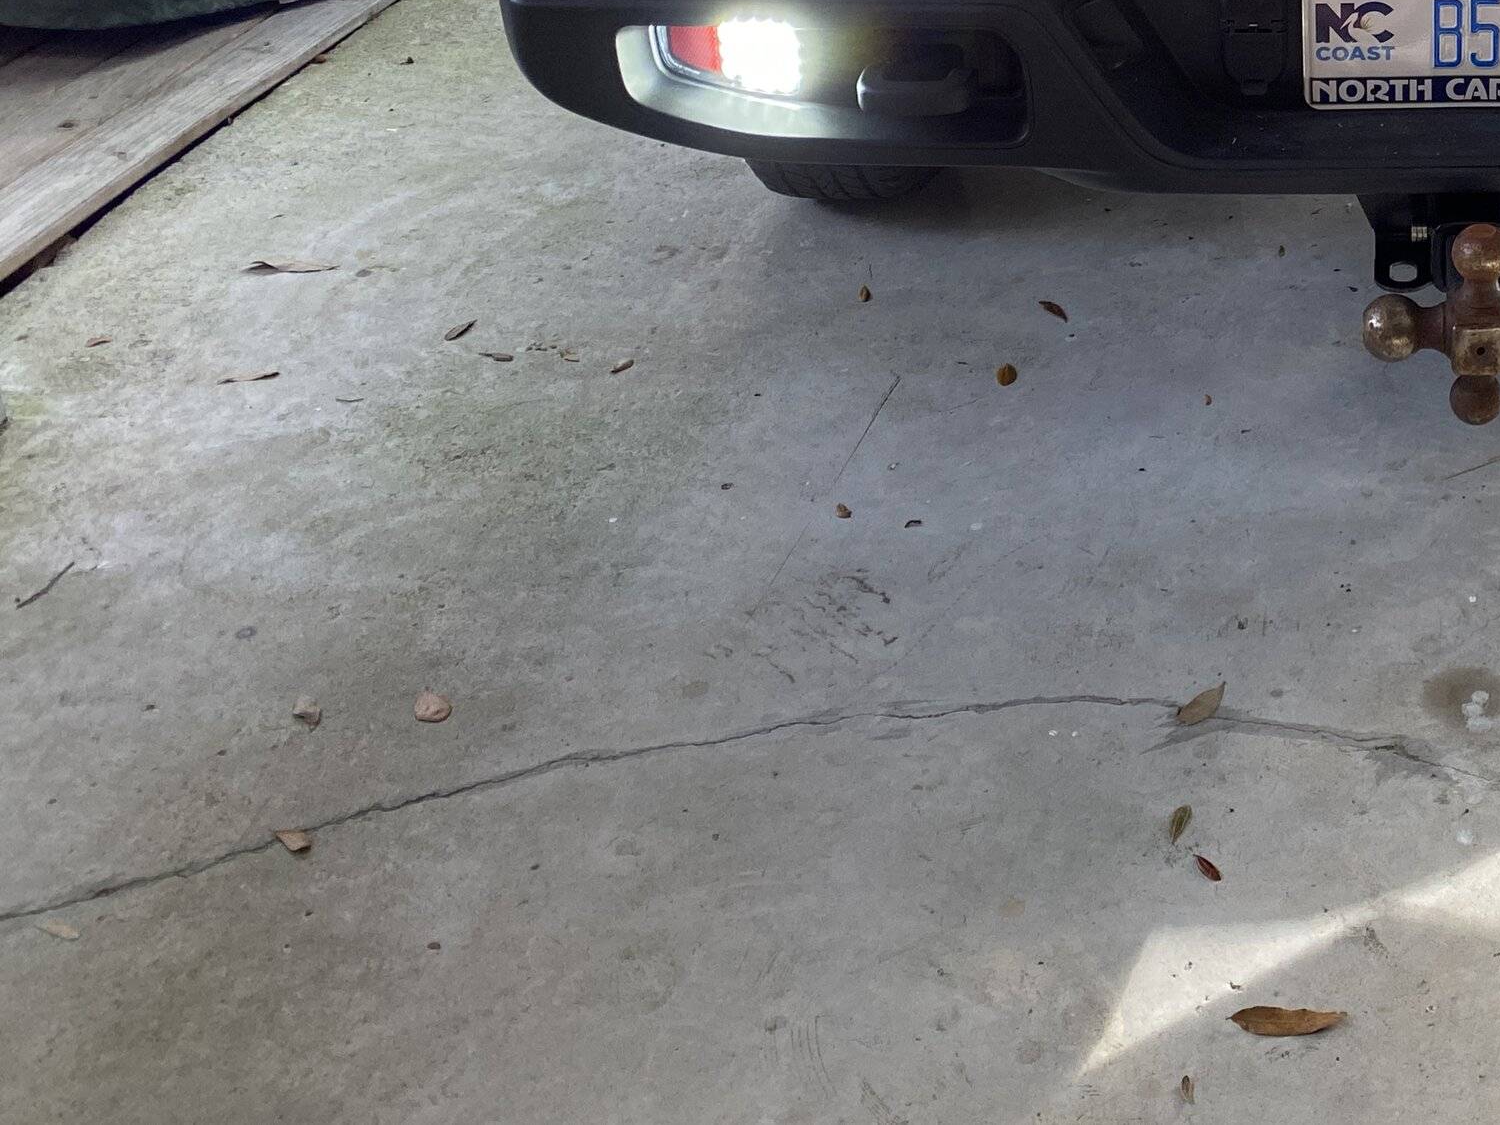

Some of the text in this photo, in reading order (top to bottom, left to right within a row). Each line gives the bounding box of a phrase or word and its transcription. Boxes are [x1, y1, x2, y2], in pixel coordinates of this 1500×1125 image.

[1315, 1, 1395, 44] NC
[1315, 46, 1395, 62] COAST
[1311, 77, 1433, 103] NORTH
